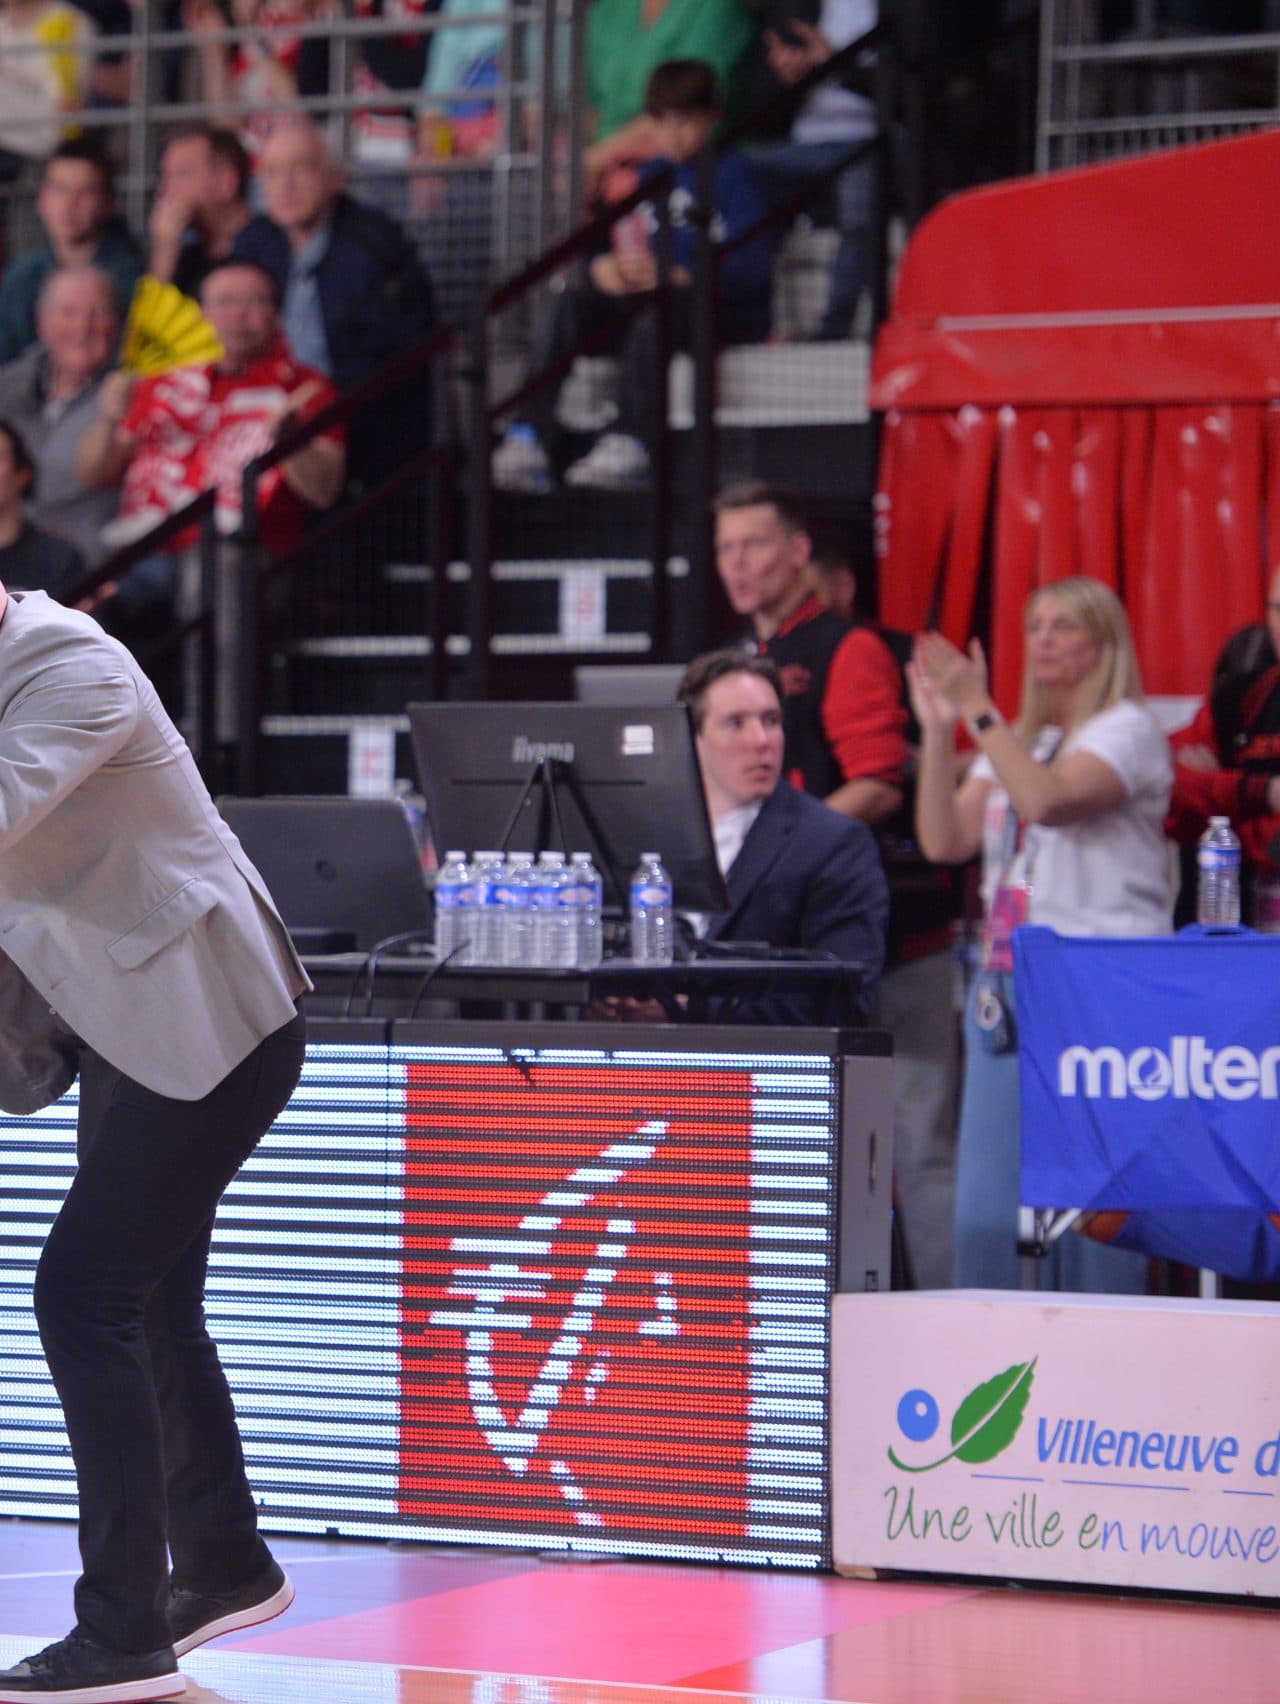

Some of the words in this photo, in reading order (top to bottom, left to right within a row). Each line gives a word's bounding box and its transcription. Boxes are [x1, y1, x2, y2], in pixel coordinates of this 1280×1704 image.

[1036, 1416, 1239, 1475] Villeneuve
[884, 1485, 972, 1542] Une
[986, 1493, 1064, 1549] ville
[1078, 1512, 1128, 1553] en
[1141, 1520, 1280, 1563] mouve
